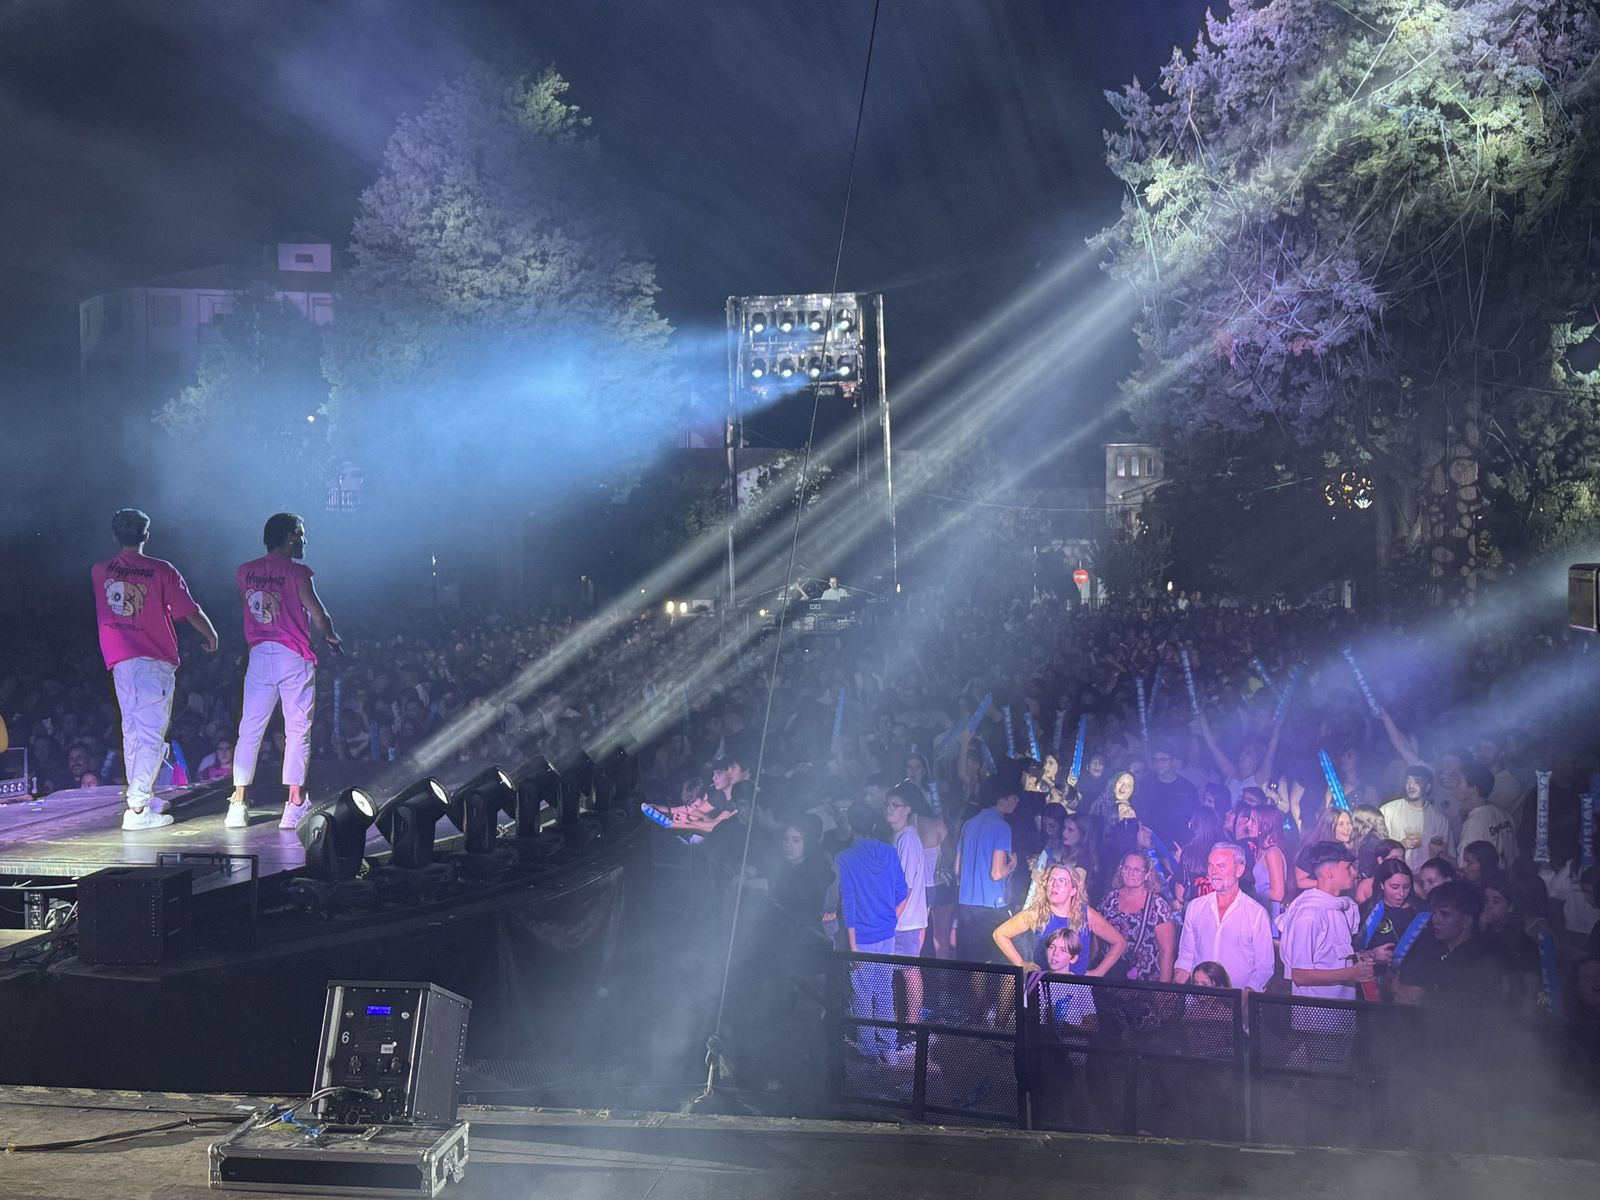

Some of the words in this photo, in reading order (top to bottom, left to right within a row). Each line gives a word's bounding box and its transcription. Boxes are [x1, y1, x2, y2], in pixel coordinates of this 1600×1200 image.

[106, 561, 155, 578] Happiness
[245, 571, 286, 588] Happiness
[341, 1031, 350, 1045] 6
